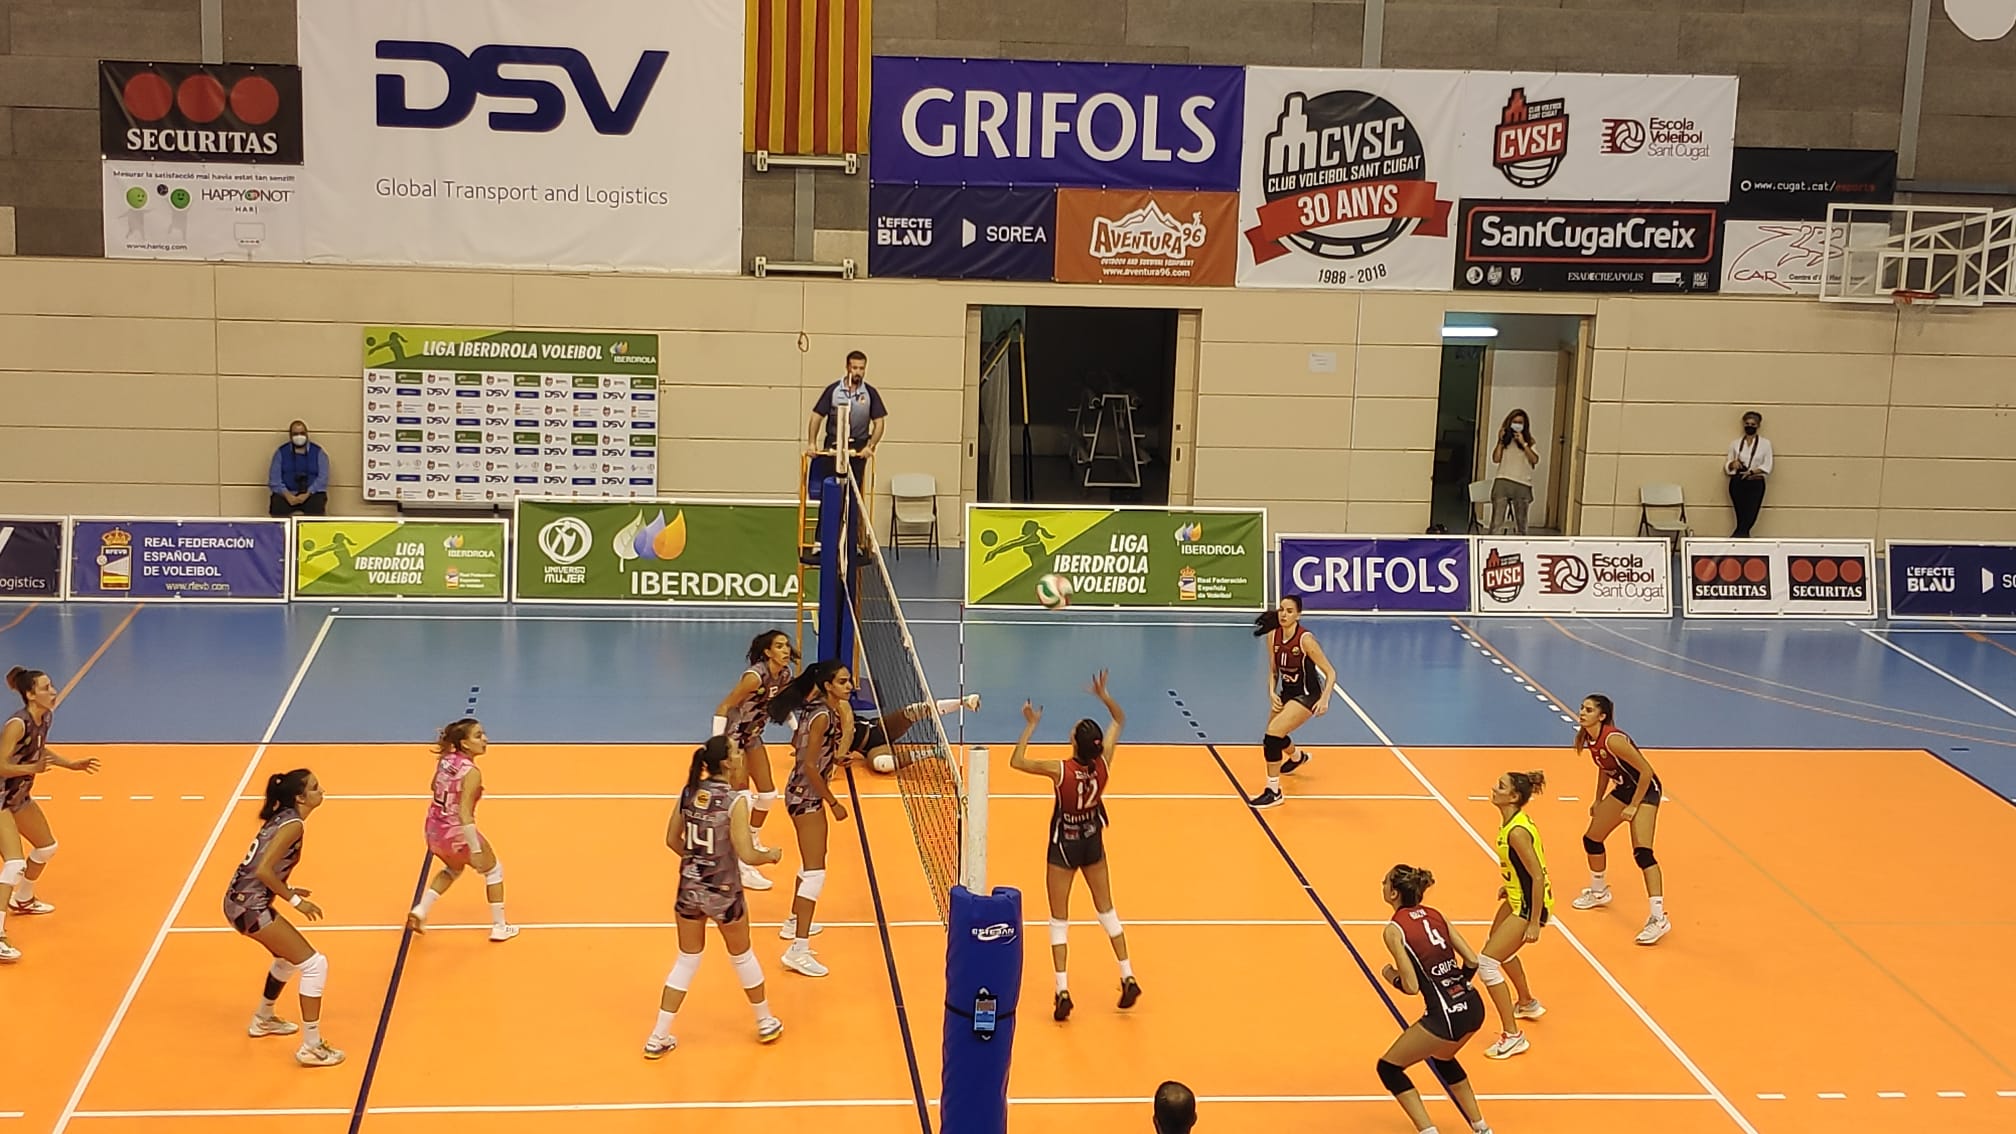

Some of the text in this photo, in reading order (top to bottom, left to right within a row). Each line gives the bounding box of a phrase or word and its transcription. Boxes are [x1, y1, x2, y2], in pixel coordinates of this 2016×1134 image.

[375, 40, 669, 135] DSV
[901, 87, 1217, 163] GRIFOLS
[1650, 117, 1694, 130] Escola
[127, 128, 278, 154] SECURITAS
[1320, 116, 1406, 167] CVSC
[1500, 122, 1562, 159] CVSC
[1650, 131, 1702, 144] Voleibol
[1648, 144, 1709, 160] Sant Cugat
[1268, 155, 1421, 193] CLUB VOLEIBOL SANT CUGAT
[376, 178, 668, 208] Global Transport and Logistics
[1297, 184, 1398, 227] 30 ANYS
[877, 216, 932, 228] L'EFECTE
[877, 229, 932, 246] BLAU
[986, 226, 1047, 242] SOREA
[1102, 268, 1190, 277] www.aventura96.com
[1318, 268, 1346, 284] 1988
[1358, 263, 1387, 283] 2018
[423, 340, 603, 360] LIGA IBERDROLA VOLEIBOL
[144, 536, 254, 549] REAL FEDERACIÓN
[395, 543, 425, 556] LIGA
[1110, 534, 1149, 553] LIGA
[1181, 544, 1245, 555] IBERDROLA
[144, 550, 207, 562] ESPAÑOLA
[355, 557, 425, 570] IBERDROLA
[1592, 553, 1643, 568] Escola
[143, 565, 221, 576] DE VOLEIBOL
[1054, 555, 1149, 574] IBERDROLA
[1906, 566, 1955, 576] L'EFECTE
[369, 571, 422, 585] VOLEIBOL
[544, 574, 586, 584] MUJER
[1293, 556, 1459, 593] GRIFOLS
[1486, 566, 1521, 588] CVSC
[1592, 568, 1654, 583] Voleibol
[632, 571, 806, 597] IBERDROLA
[1072, 575, 1147, 594] VOLEIBOL
[1696, 585, 1767, 597] SECURITAS
[1793, 585, 1862, 598] SECURITAS
[1907, 577, 1956, 592] BLAU
[1592, 583, 1664, 602] Sant Cugat
[1280, 652, 1288, 667] 11
[1077, 778, 1098, 810] 12
[687, 821, 714, 854] 14
[1422, 919, 1447, 950] 4
